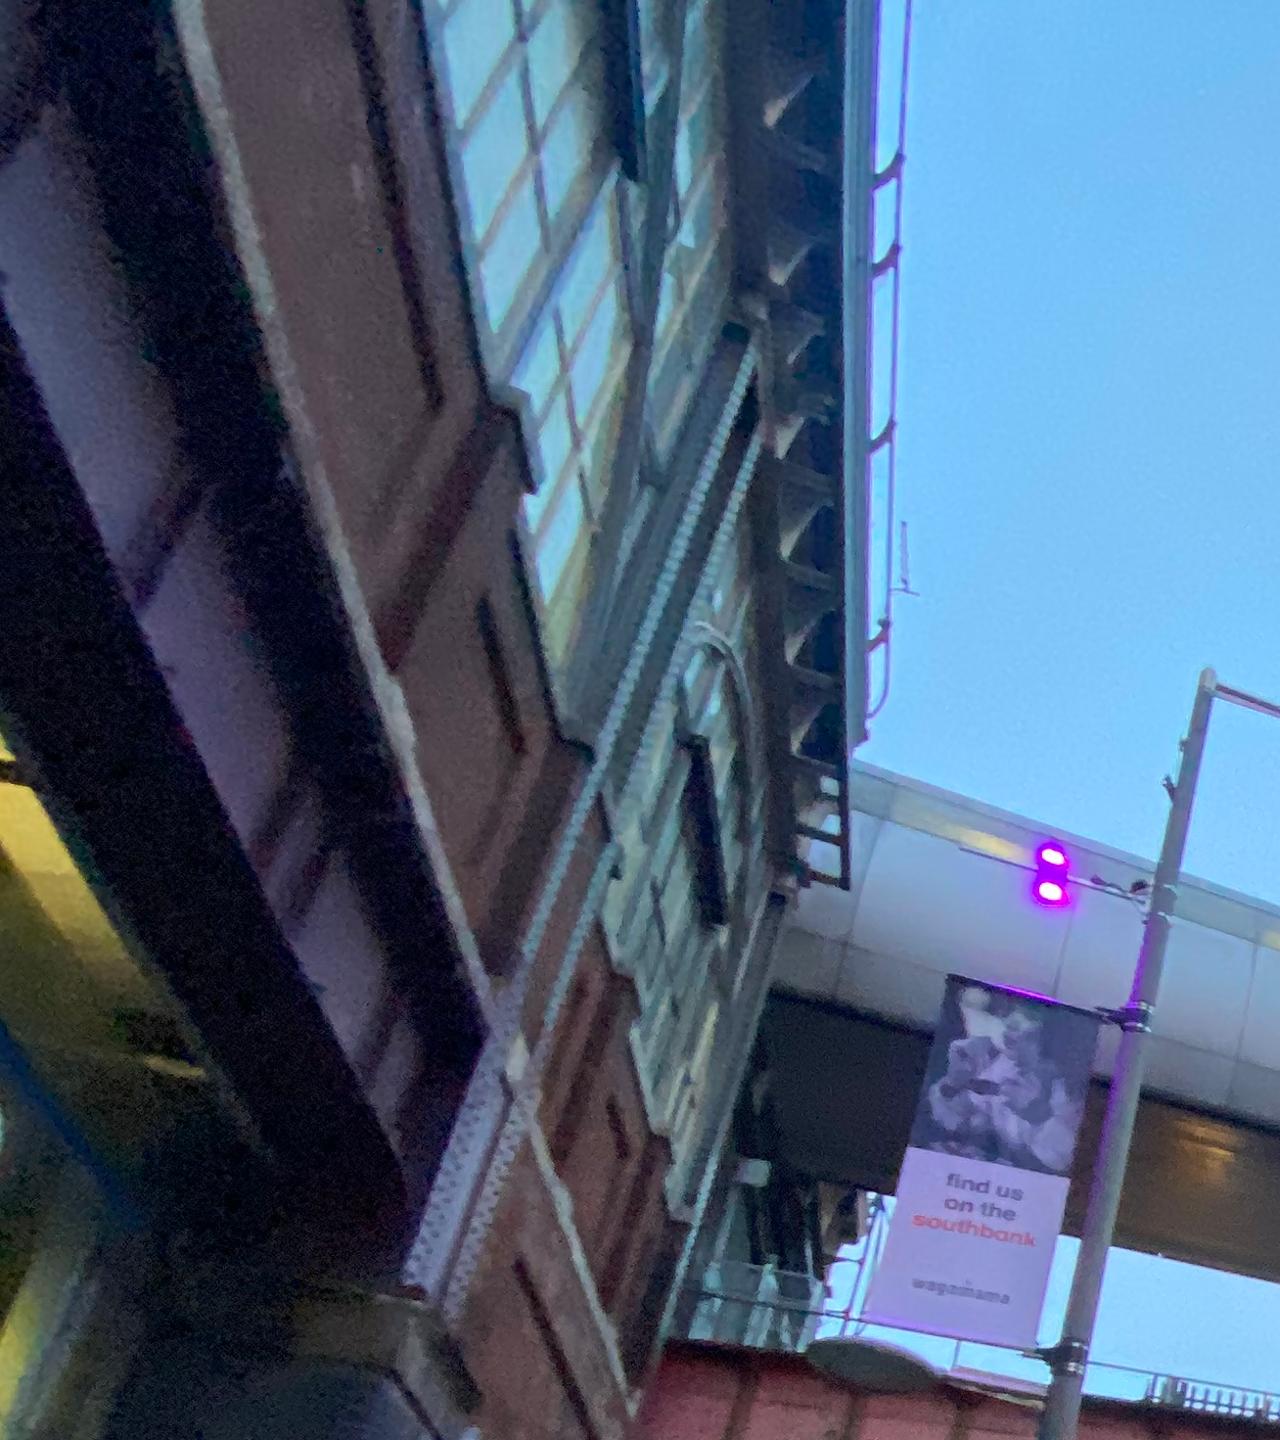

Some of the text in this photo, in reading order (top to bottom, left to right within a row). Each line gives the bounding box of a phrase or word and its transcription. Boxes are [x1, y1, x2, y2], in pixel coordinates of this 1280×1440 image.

[946, 1173, 1024, 1202] find us
[944, 1198, 1017, 1221] on the
[912, 1215, 1037, 1248] southbank
